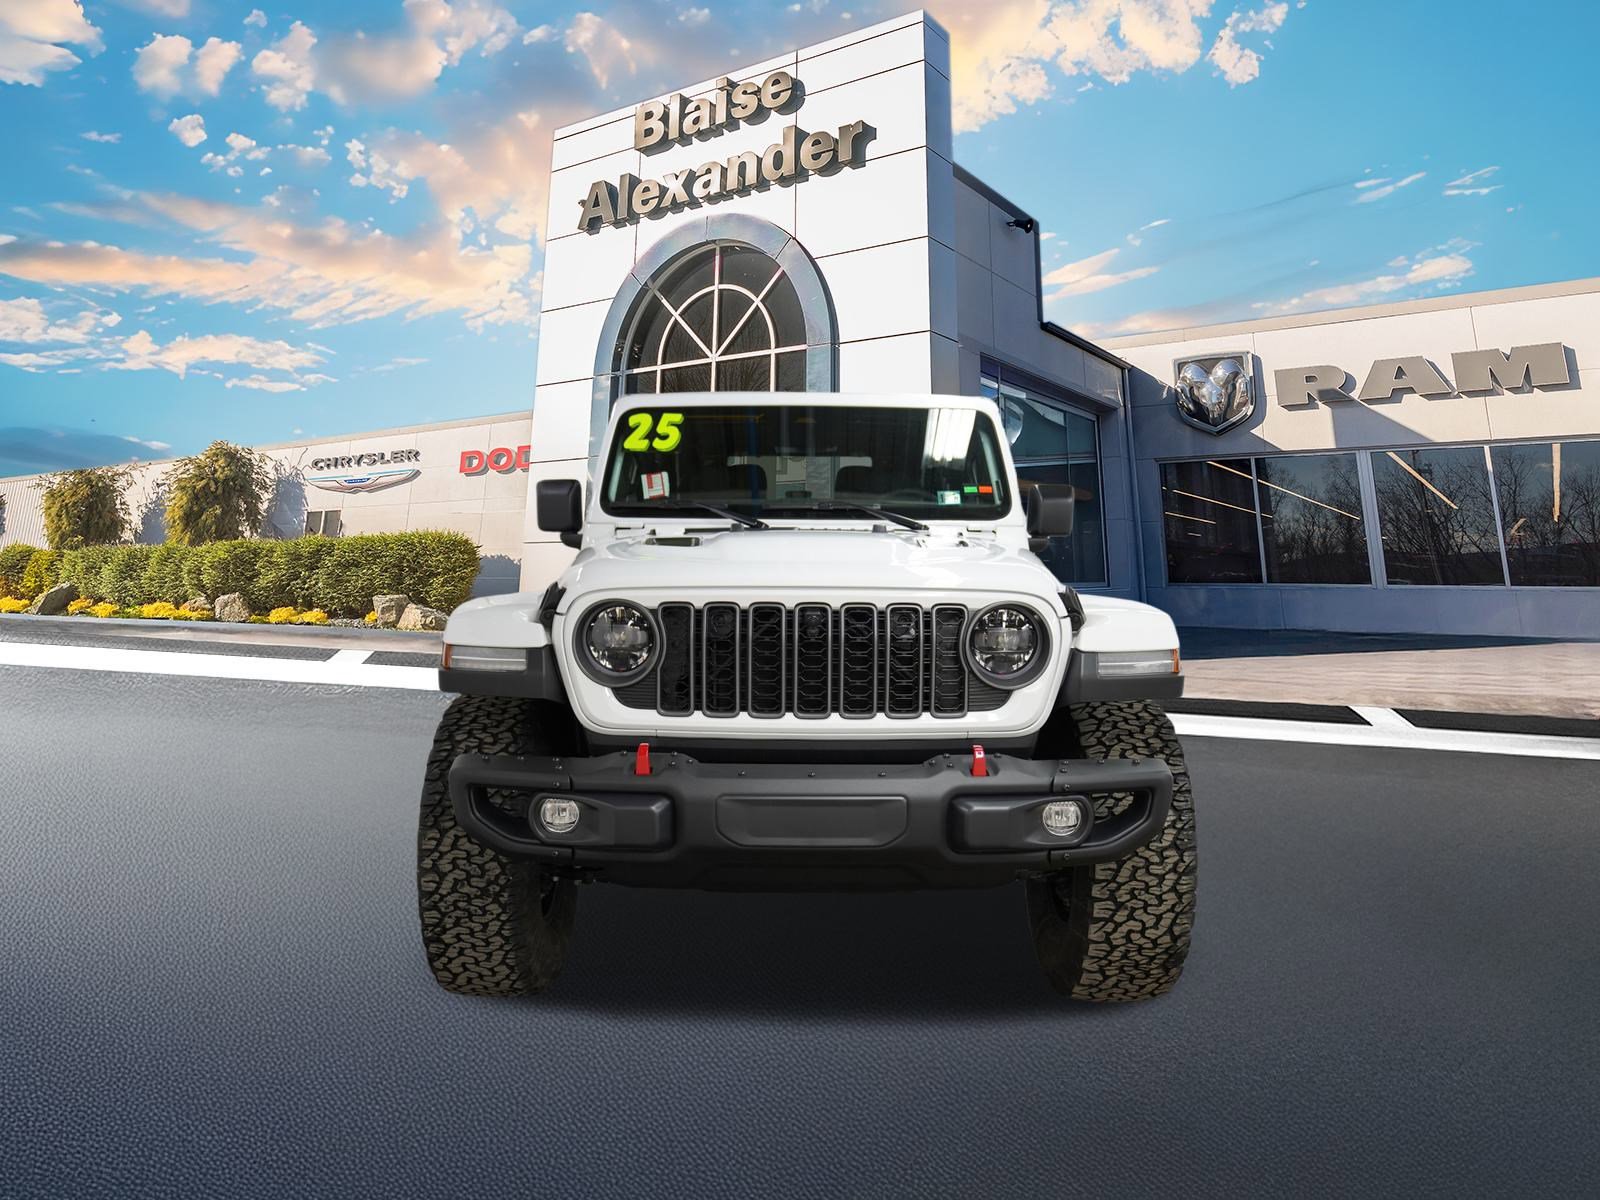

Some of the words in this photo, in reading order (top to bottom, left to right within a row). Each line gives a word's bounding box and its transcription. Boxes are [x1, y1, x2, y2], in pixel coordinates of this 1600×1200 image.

[635, 71, 804, 156] Blaise
[578, 120, 876, 235] Alexander
[1275, 342, 1570, 406] RAM
[311, 448, 421, 471] CHRYSLER
[623, 413, 684, 452] 25
